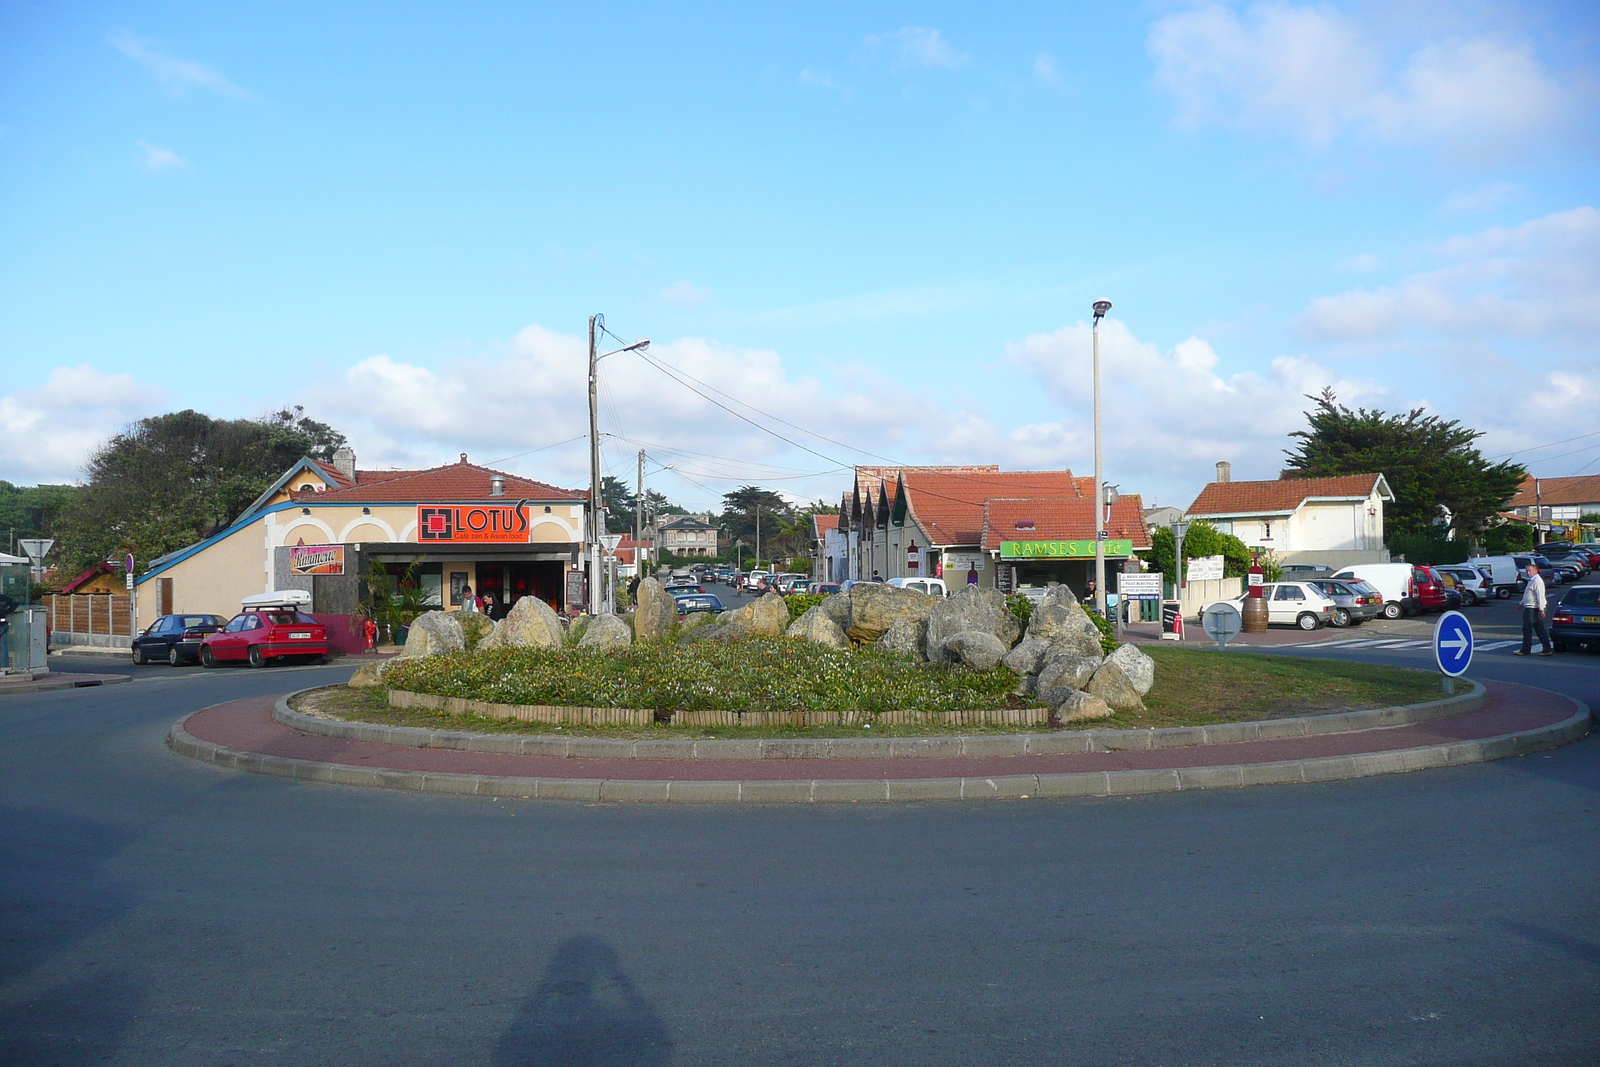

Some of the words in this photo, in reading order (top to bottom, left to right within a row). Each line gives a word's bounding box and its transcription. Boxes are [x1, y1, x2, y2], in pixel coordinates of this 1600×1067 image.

[455, 498, 528, 532] LOTUS
[1012, 542, 1077, 556] RAMSES
[1087, 541, 1121, 555] Cfé
